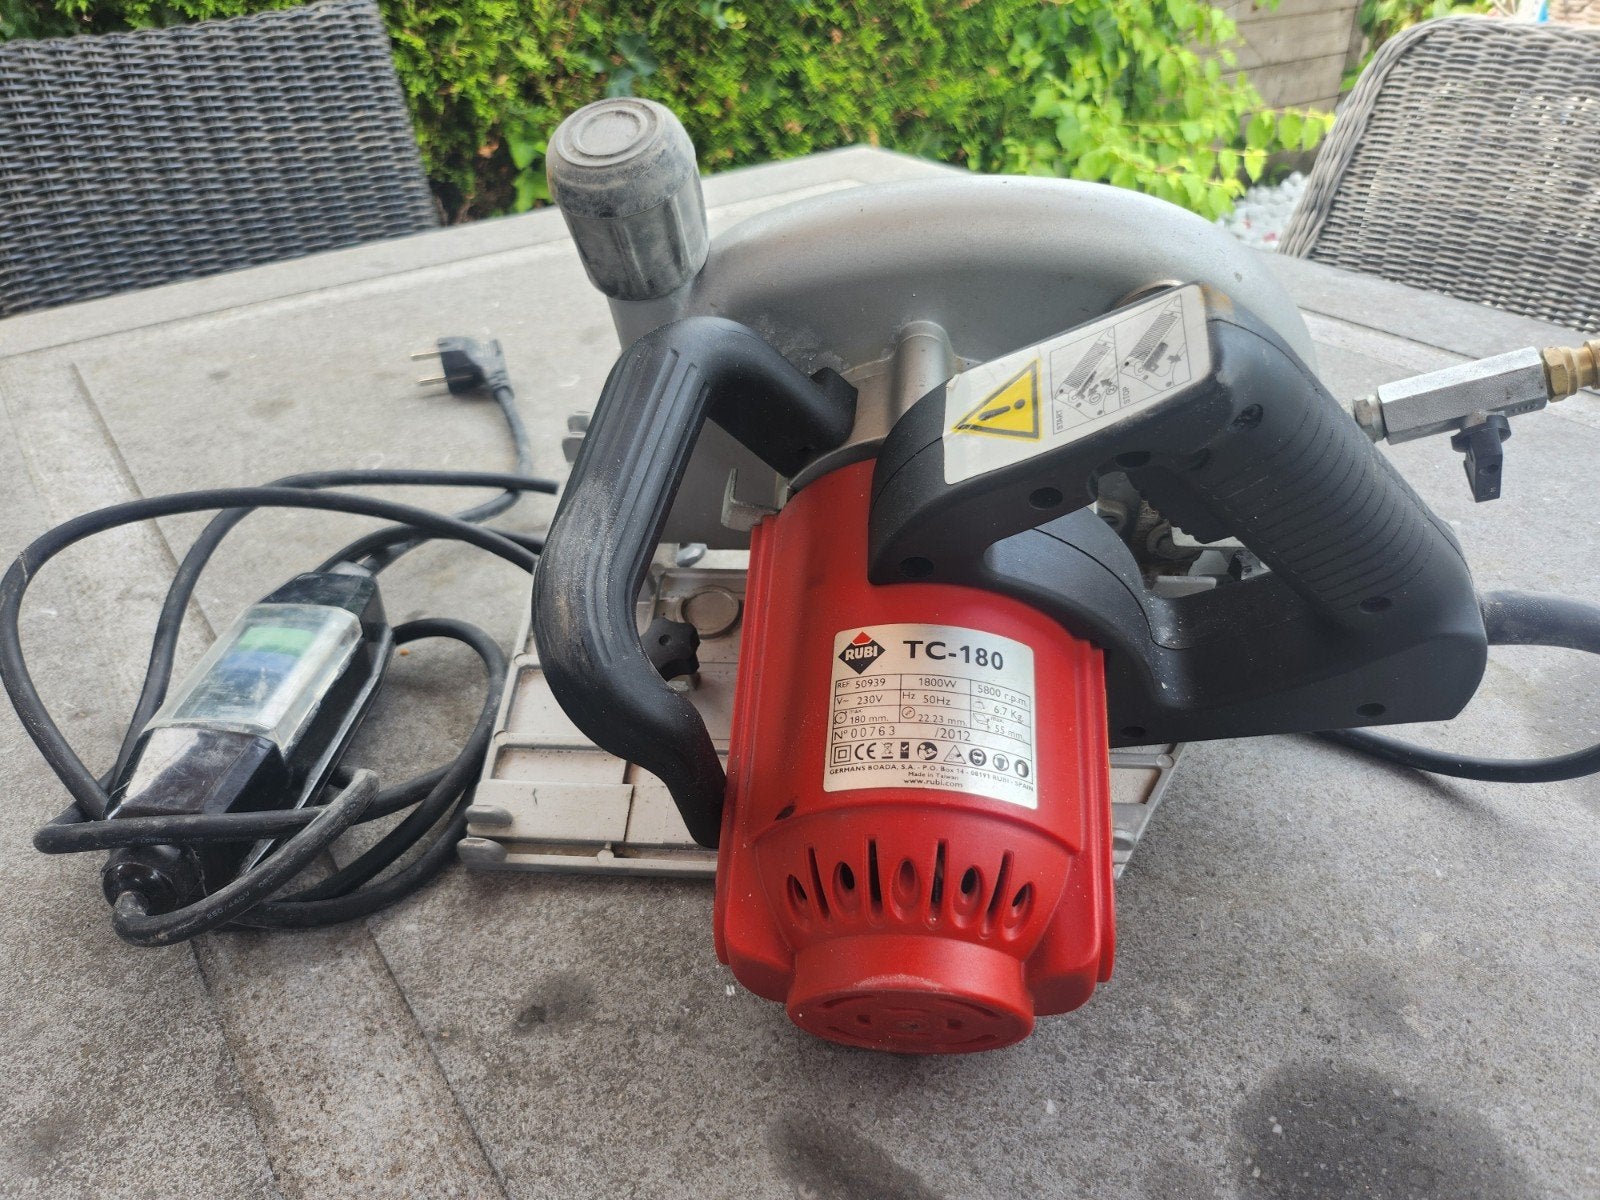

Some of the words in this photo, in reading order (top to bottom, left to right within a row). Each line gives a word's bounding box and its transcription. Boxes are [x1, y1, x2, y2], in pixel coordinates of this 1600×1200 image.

[1056, 410, 1064, 431] START
[845, 645, 878, 661] RUBI
[903, 640, 1004, 671] TC-180
[855, 678, 886, 689] 50939
[919, 678, 957, 688] 1800W
[902, 691, 916, 700] Hz
[977, 684, 1001, 698] 5800
[857, 695, 883, 706] 230V
[923, 695, 951, 706] 50Hz
[993, 705, 1008, 716] 6.7
[850, 715, 866, 724] 180
[994, 725, 1005, 735] 55
[829, 765, 866, 775] GERMANS
[940, 765, 954, 773] Box
[1014, 781, 1034, 792] SPAIN
[936, 773, 959, 781] Taiwan
[904, 779, 963, 788] www.rubi.com
